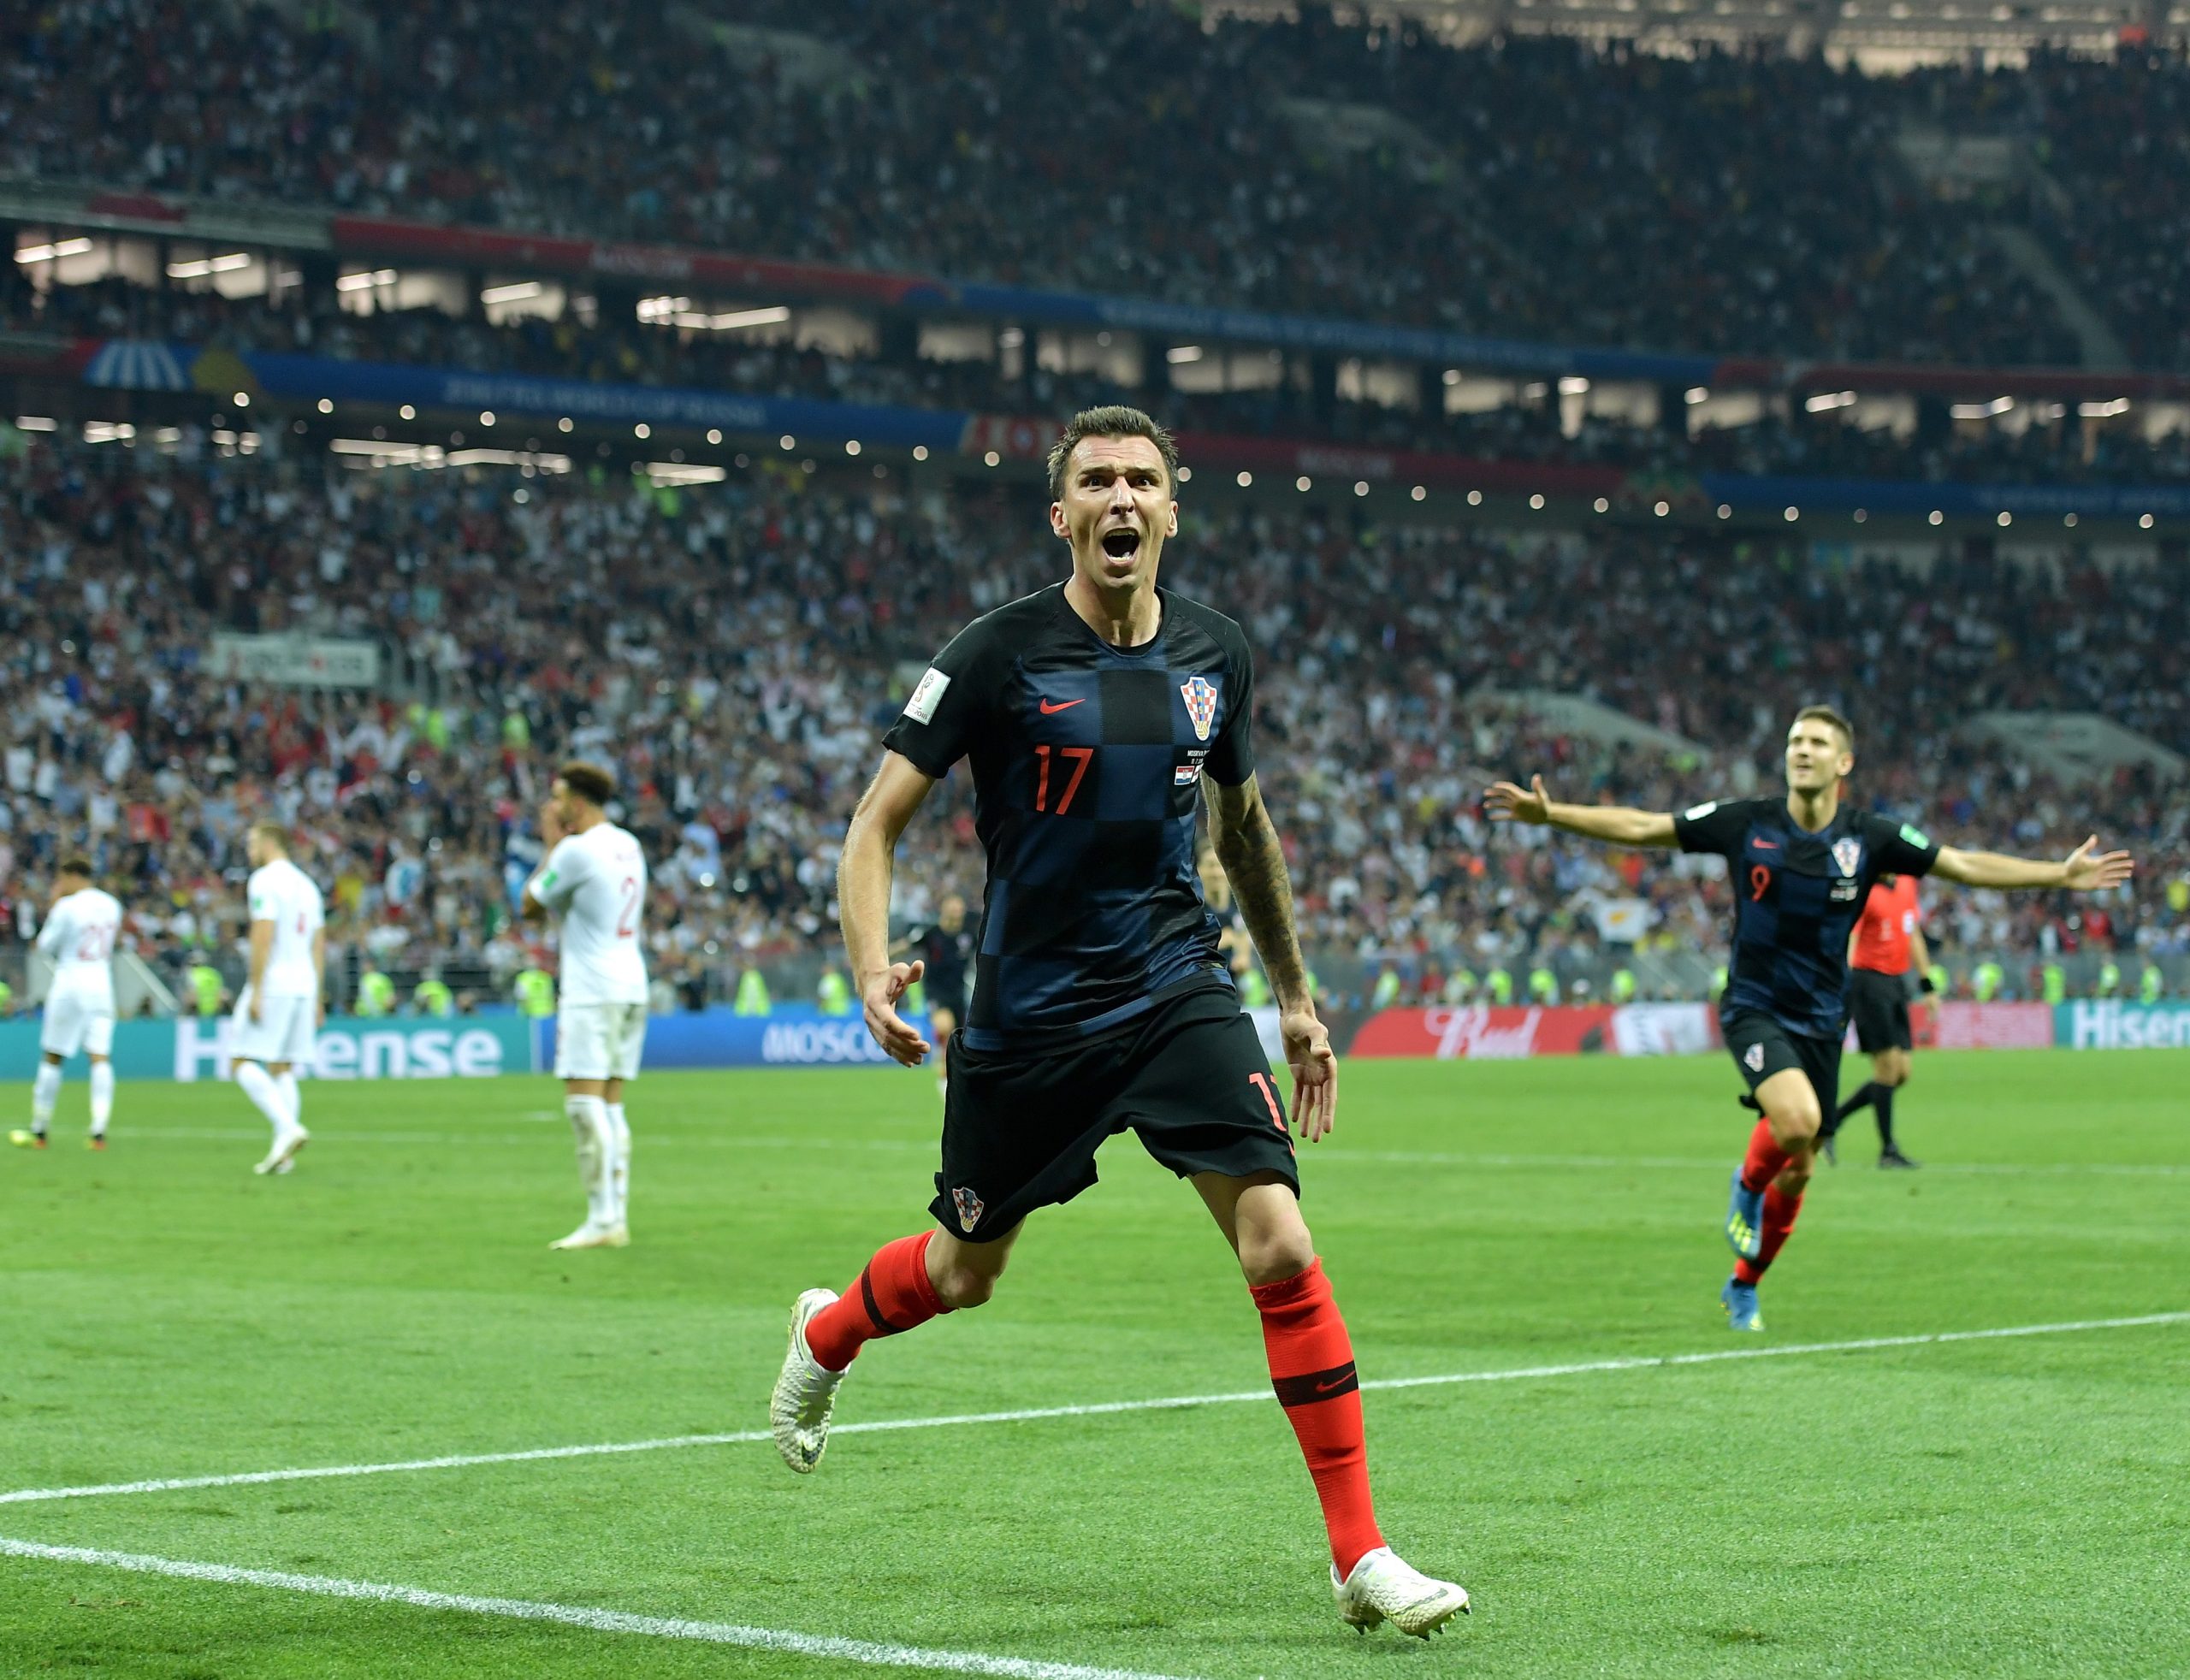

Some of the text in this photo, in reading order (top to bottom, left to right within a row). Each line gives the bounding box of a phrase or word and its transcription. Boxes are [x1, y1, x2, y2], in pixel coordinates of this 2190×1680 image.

[1035, 745, 1094, 815] 17
[617, 877, 640, 938] 2
[1751, 864, 1772, 902] 9
[175, 1019, 503, 1081] Hense
[761, 1021, 922, 1062] MOSCO
[1249, 1072, 1290, 1138] 1
